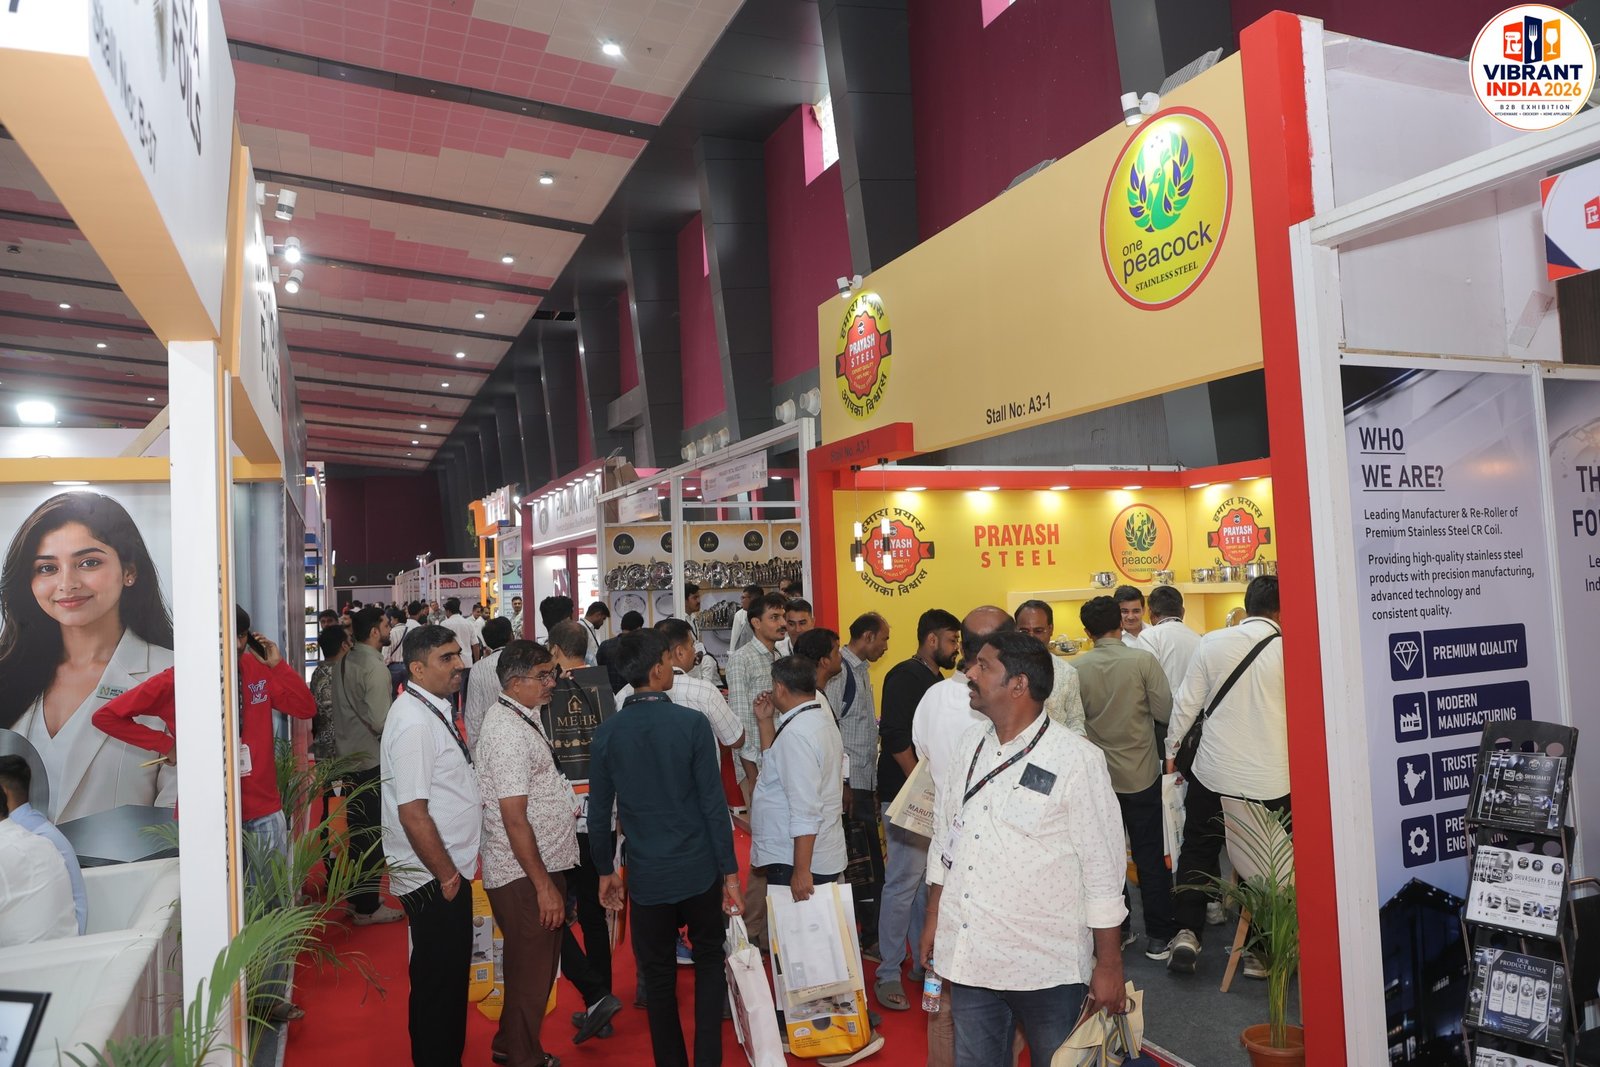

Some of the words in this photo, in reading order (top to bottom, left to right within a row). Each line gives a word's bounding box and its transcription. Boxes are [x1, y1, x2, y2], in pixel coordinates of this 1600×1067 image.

[1122, 239, 1143, 257] one
[1123, 221, 1214, 285] peacock
[1135, 269, 1174, 293] STAINLESS
[1173, 260, 1199, 278] STEEL
[849, 333, 876, 357] PRAYASH
[851, 350, 875, 368] STEEL
[986, 405, 1007, 425] Stall
[1009, 402, 1026, 419] No:
[1028, 392, 1051, 414] A3-1
[1359, 427, 1404, 451] WHO
[1362, 465, 1392, 488] WE
[1398, 465, 1445, 488] ARE?
[893, 507, 926, 533] प्रयास
[1364, 508, 1401, 522] Leading
[1402, 508, 1460, 520] Manufacturer
[1462, 508, 1469, 518] &
[1469, 507, 1508, 519] Re-Roller
[1509, 506, 1519, 517] of
[1572, 509, 1600, 537] FO
[974, 523, 1059, 547] PRAYASH
[1223, 525, 1253, 537] PRAYASH
[1225, 536, 1252, 545] STEEL
[1365, 526, 1407, 538] Premium
[1408, 525, 1447, 537] Stainless
[1448, 525, 1470, 536] Steel
[1471, 525, 1483, 535] CR
[1484, 524, 1503, 535] Coil.
[874, 538, 912, 550] PYASH
[876, 549, 911, 559] SEEL
[981, 549, 1056, 568] STEEL
[1122, 554, 1164, 568] peacock
[1368, 552, 1411, 567] Providing
[1413, 551, 1464, 565] high-quality
[1466, 550, 1503, 561] stainless
[1504, 548, 1524, 559] steel
[1369, 572, 1409, 585] products
[1410, 571, 1431, 582] with
[1432, 569, 1470, 582] precision
[1471, 566, 1535, 580] manufacturing,
[1371, 589, 1413, 602] advanced
[1415, 587, 1464, 601] technology
[1465, 585, 1481, 596] and
[1372, 607, 1418, 620] consistent
[1420, 604, 1453, 619] quality.
[1433, 643, 1478, 661] PREMIUM
[1480, 639, 1518, 656] QUALITY
[1437, 693, 1478, 711] MODERN
[1438, 707, 1517, 731] MANUFACTURING
[1441, 753, 1479, 772] TRUSTE
[1443, 774, 1470, 792] INDIA
[1500, 960, 1528, 971] PRODUCT
[1527, 965, 1548, 975] RANGE
